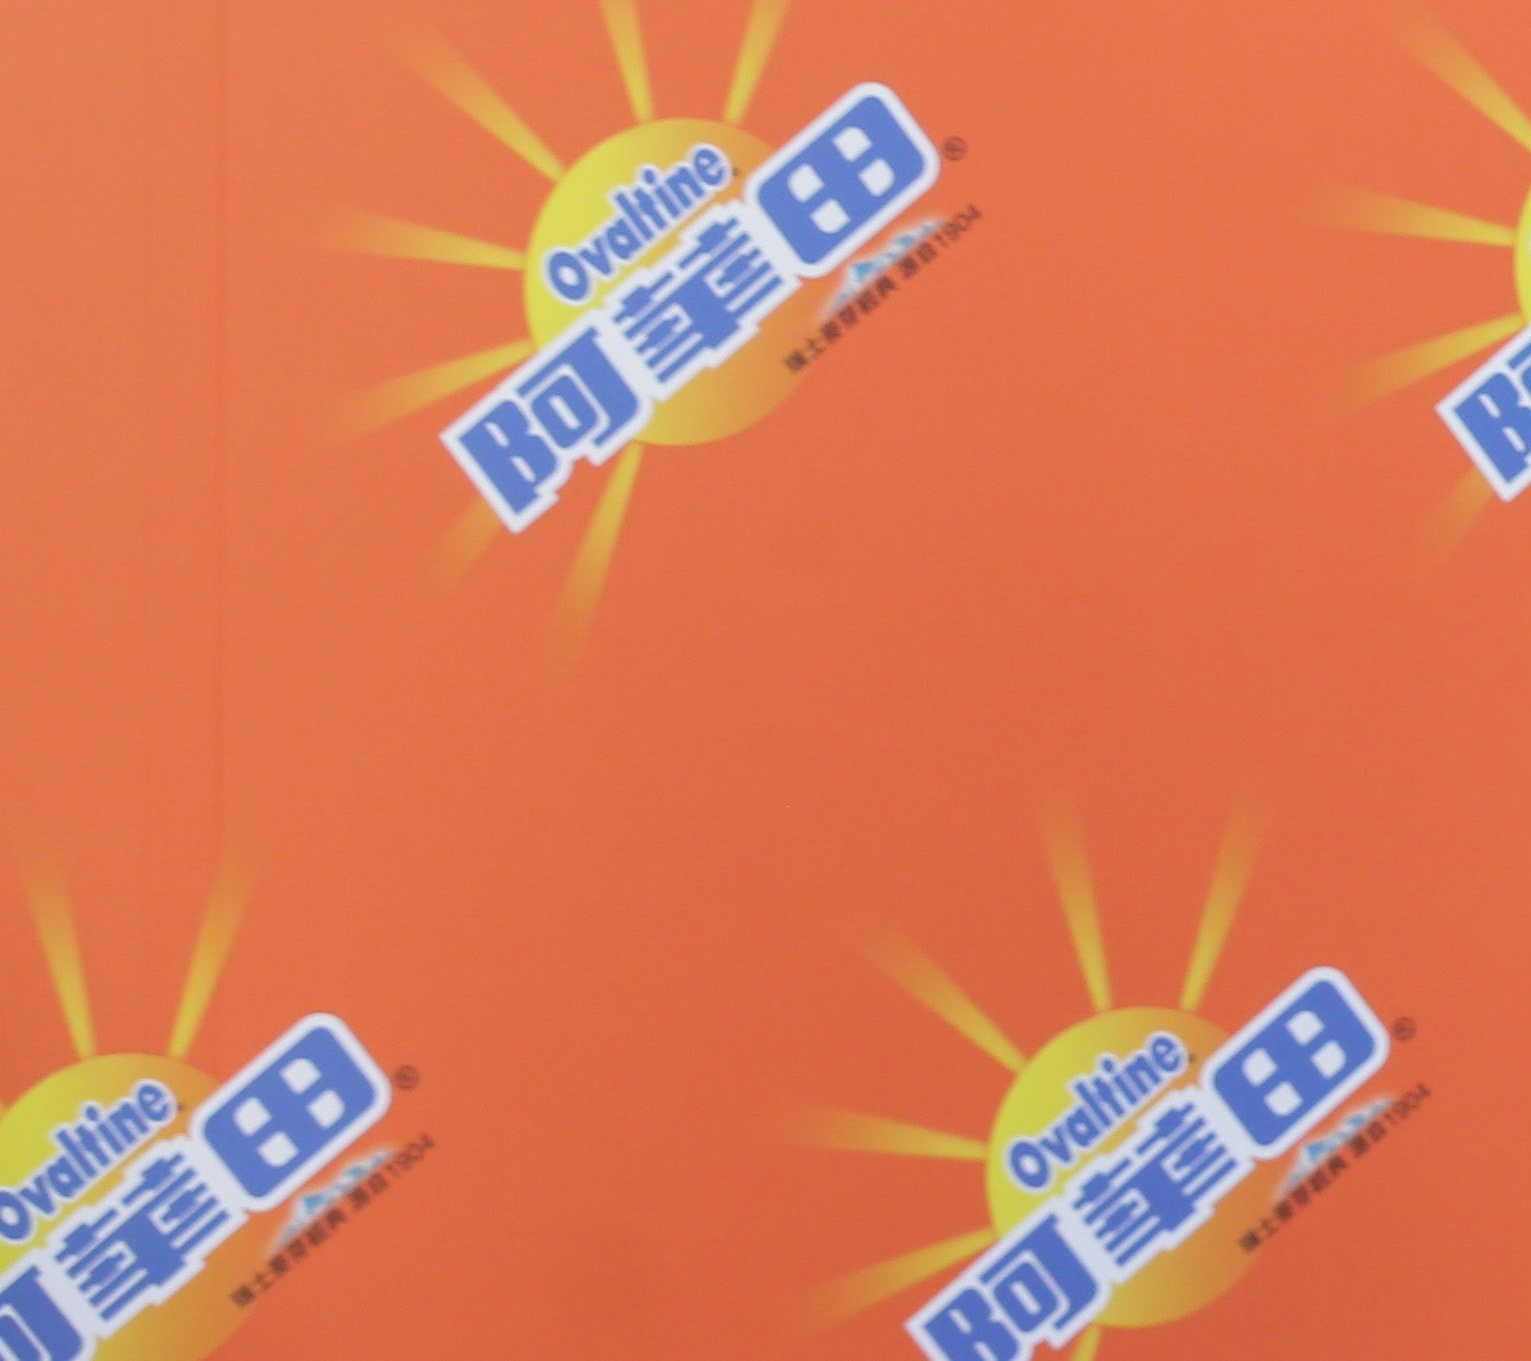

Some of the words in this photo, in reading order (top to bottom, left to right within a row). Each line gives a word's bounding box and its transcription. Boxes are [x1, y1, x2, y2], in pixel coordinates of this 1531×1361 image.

[459, 96, 925, 515] 阿華田
[547, 147, 726, 301] Ovaltine
[0, 1084, 170, 1241] Ovaltine
[0, 1027, 376, 1361] 華田
[925, 979, 1376, 1361] 阿華田
[1010, 1038, 1181, 1188] Ovaltine
